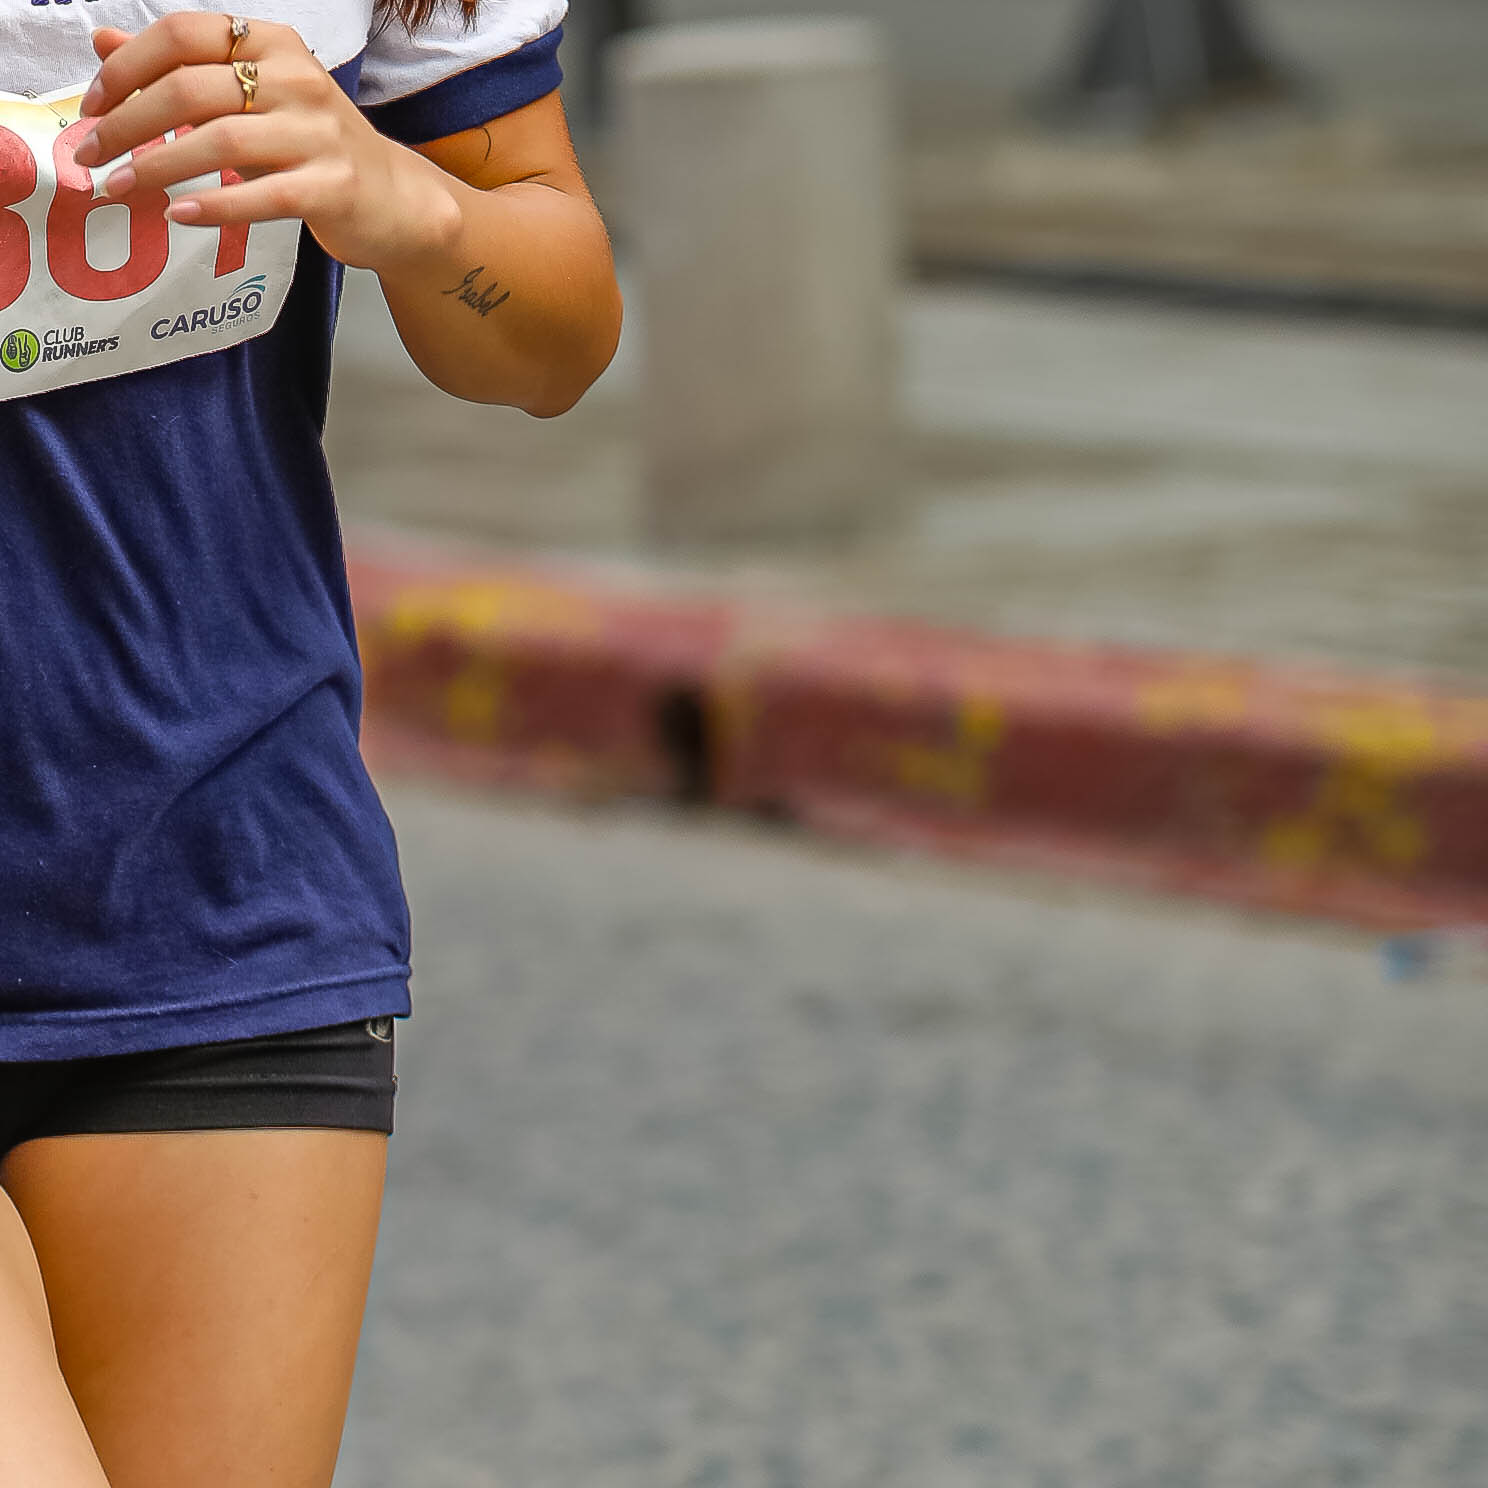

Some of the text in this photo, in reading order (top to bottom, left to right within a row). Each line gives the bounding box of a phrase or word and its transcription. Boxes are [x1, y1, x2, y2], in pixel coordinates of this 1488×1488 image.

[150, 291, 262, 340] CARUSO
[212, 311, 261, 335] SEGUROS
[42, 335, 120, 362] RUNNER'S
[43, 326, 85, 346] CLUB
